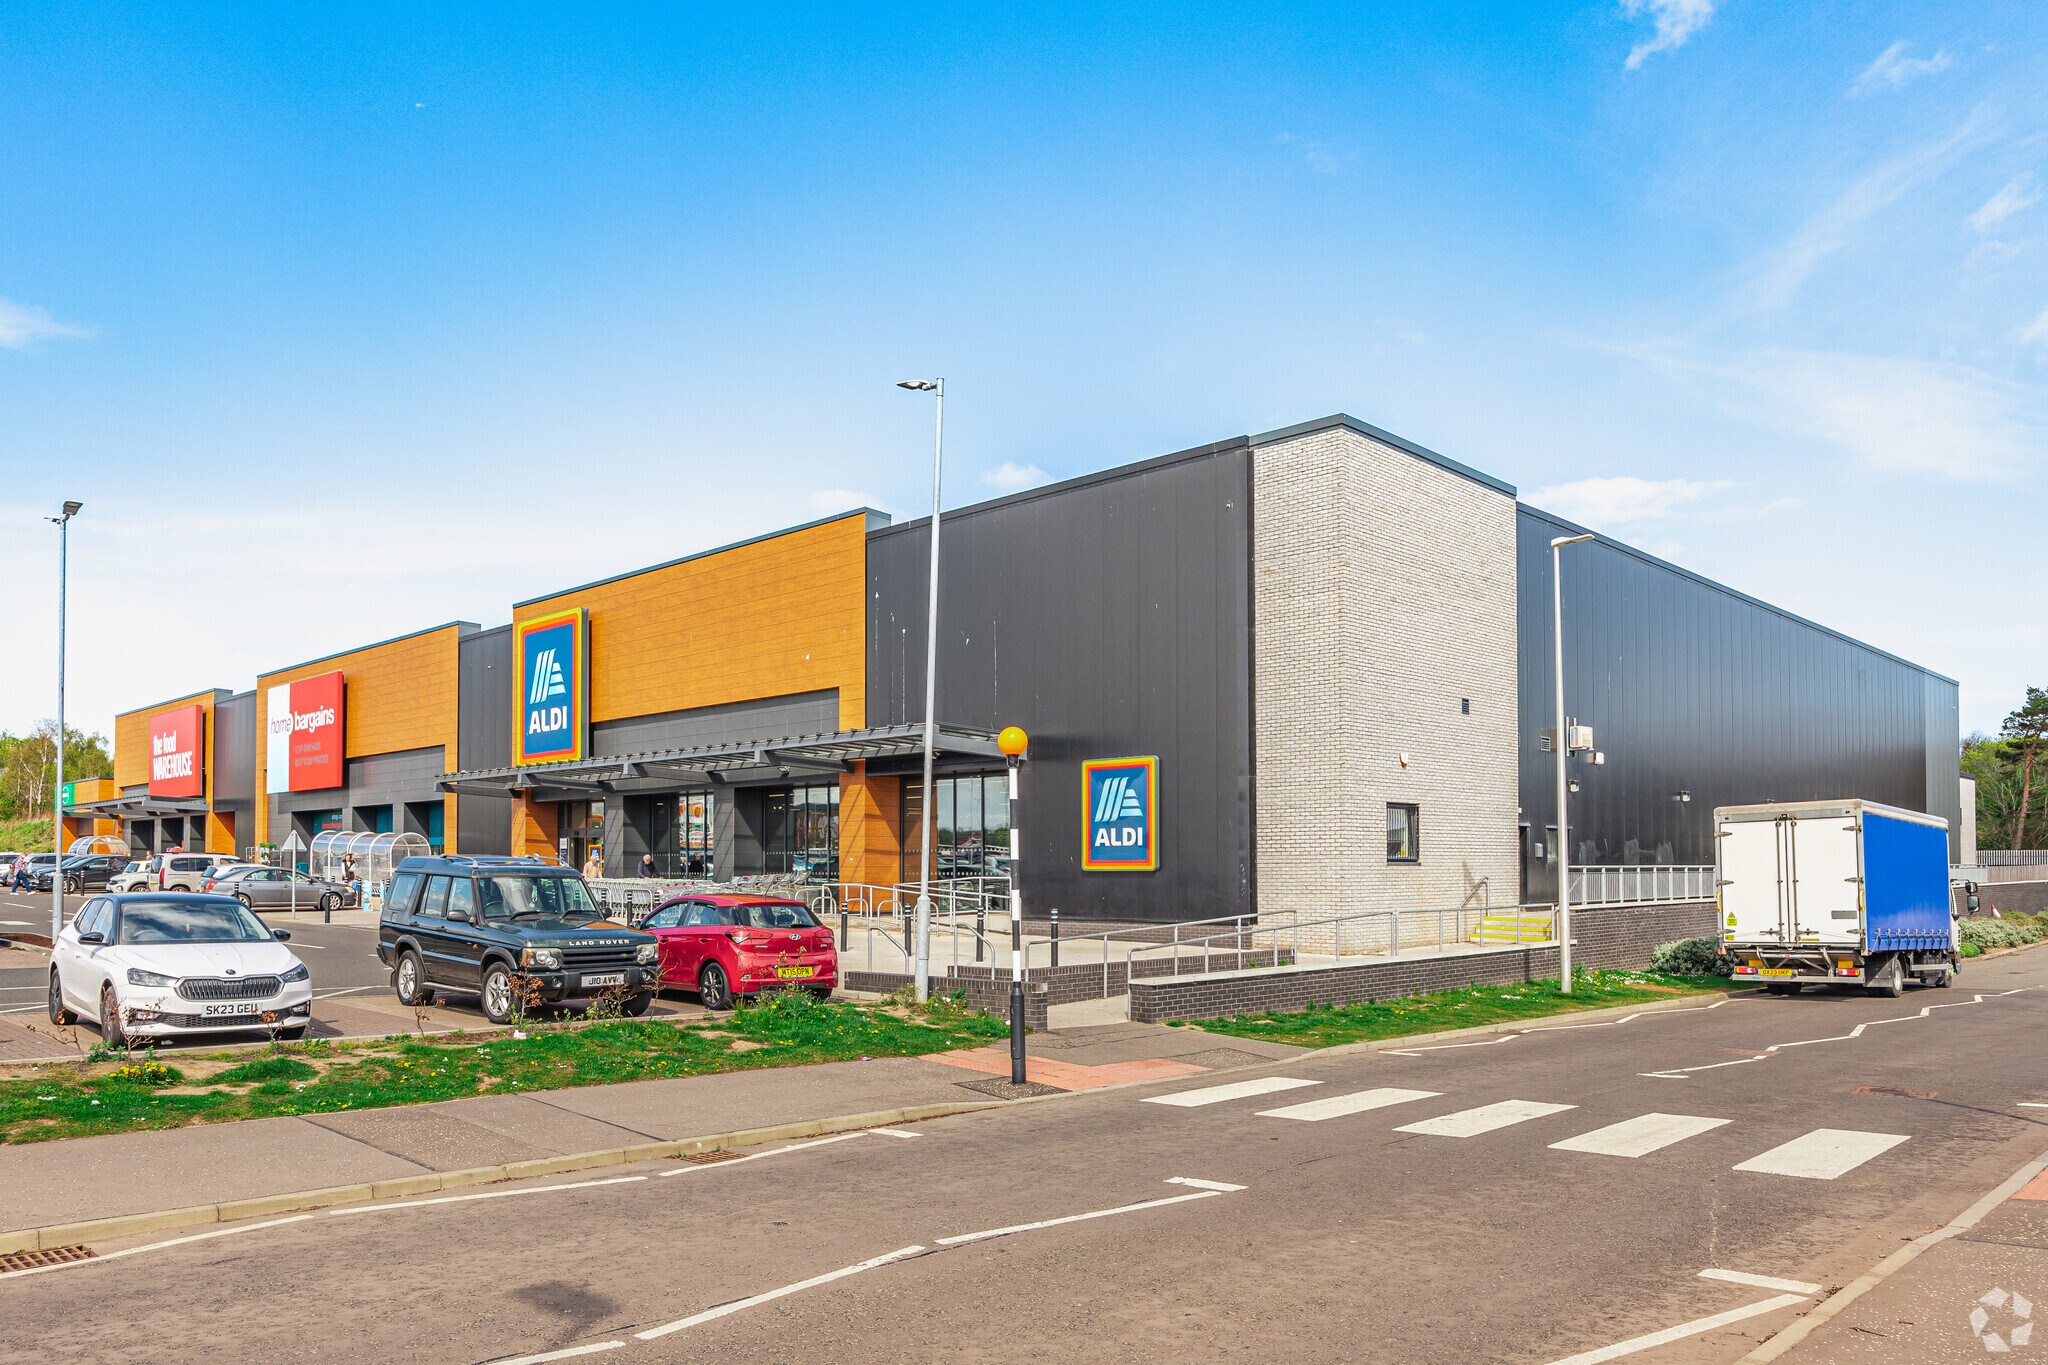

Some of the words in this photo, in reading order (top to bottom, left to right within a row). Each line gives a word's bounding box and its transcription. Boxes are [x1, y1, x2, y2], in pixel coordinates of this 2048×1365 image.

[270, 717, 291, 735] home
[294, 705, 335, 733] bargains
[529, 705, 568, 734] ALDI
[163, 730, 177, 754] food
[152, 750, 193, 781] WAREHOUSE
[1094, 827, 1143, 847] ALDI
[206, 1004, 234, 1015] SK23
